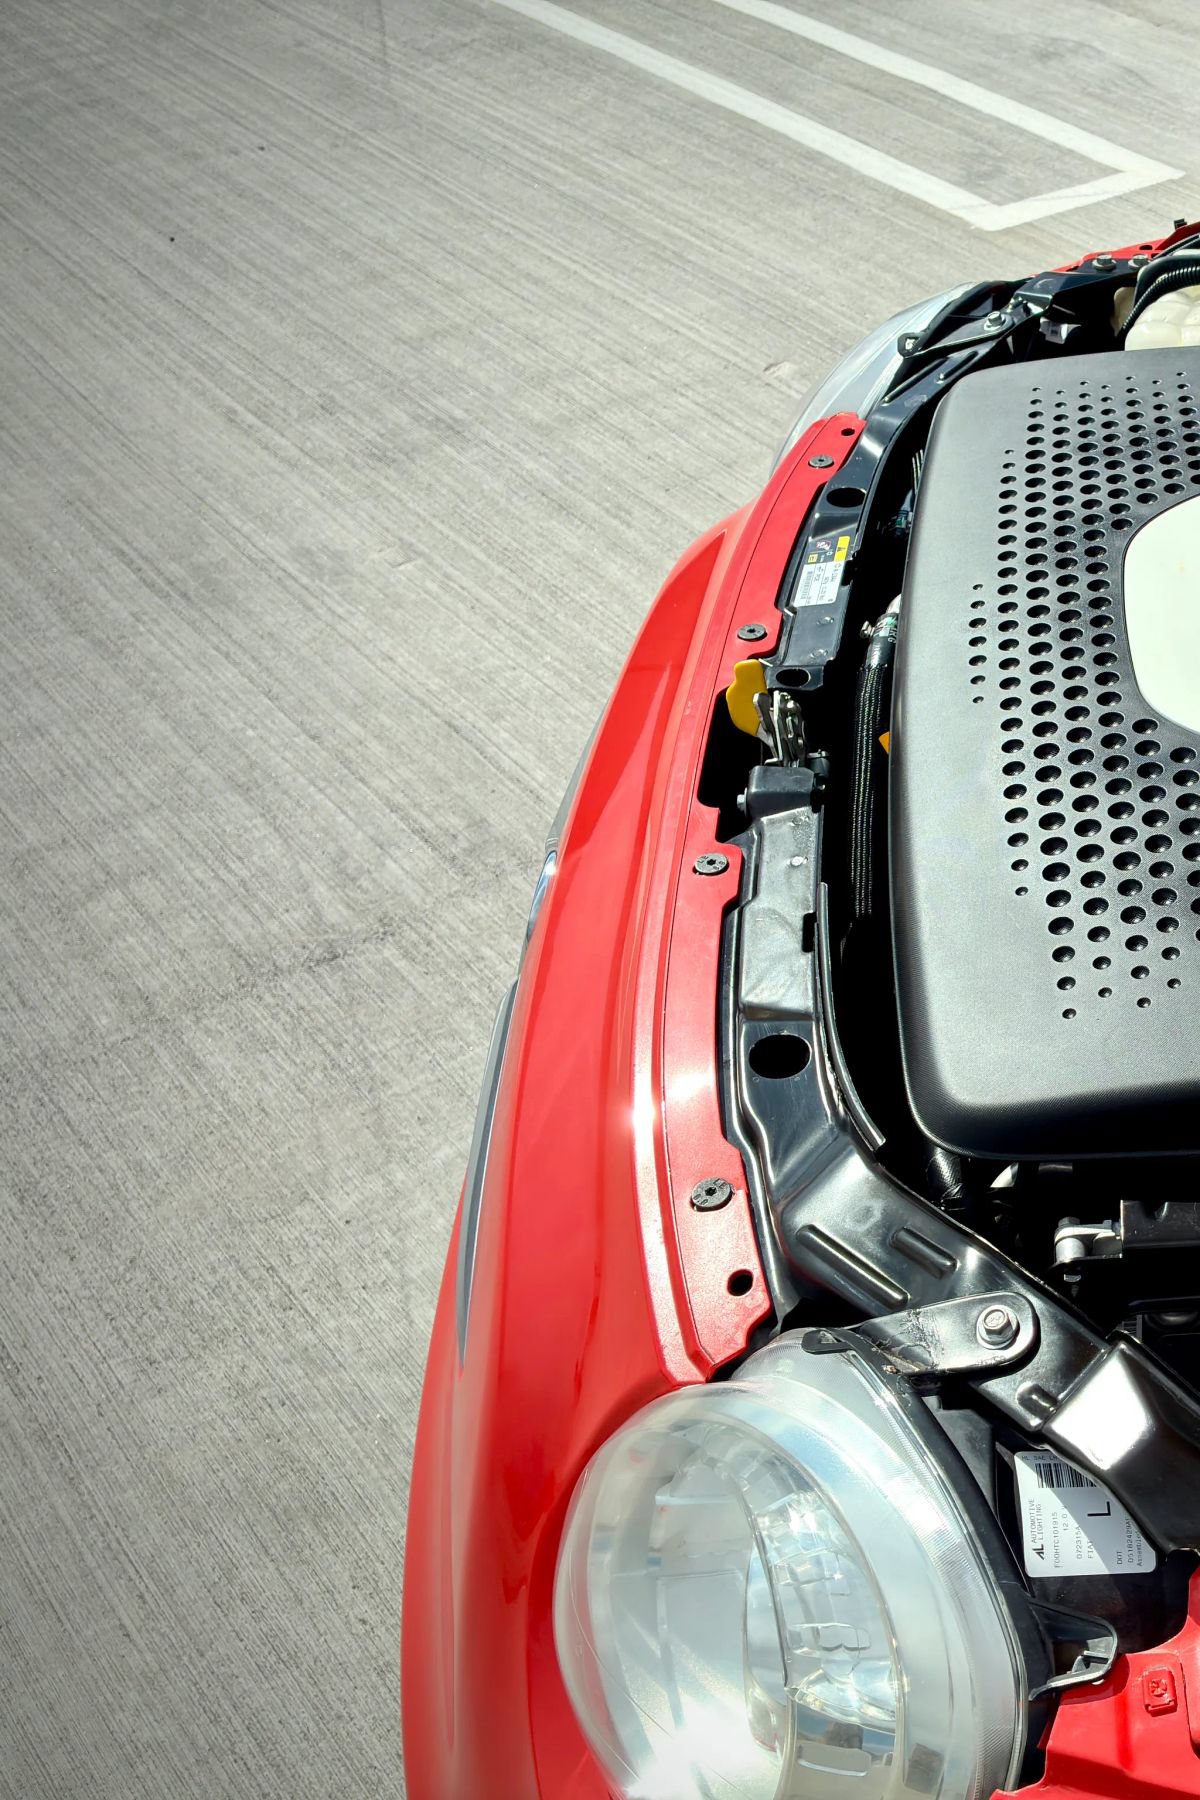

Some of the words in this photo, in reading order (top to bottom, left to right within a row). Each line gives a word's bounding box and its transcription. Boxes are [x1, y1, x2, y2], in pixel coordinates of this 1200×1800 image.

[1029, 1499, 1037, 1543] AUTOMOTIVE
[1036, 1503, 1044, 1543] LIGHTING
[1087, 1501, 1111, 1517] L
